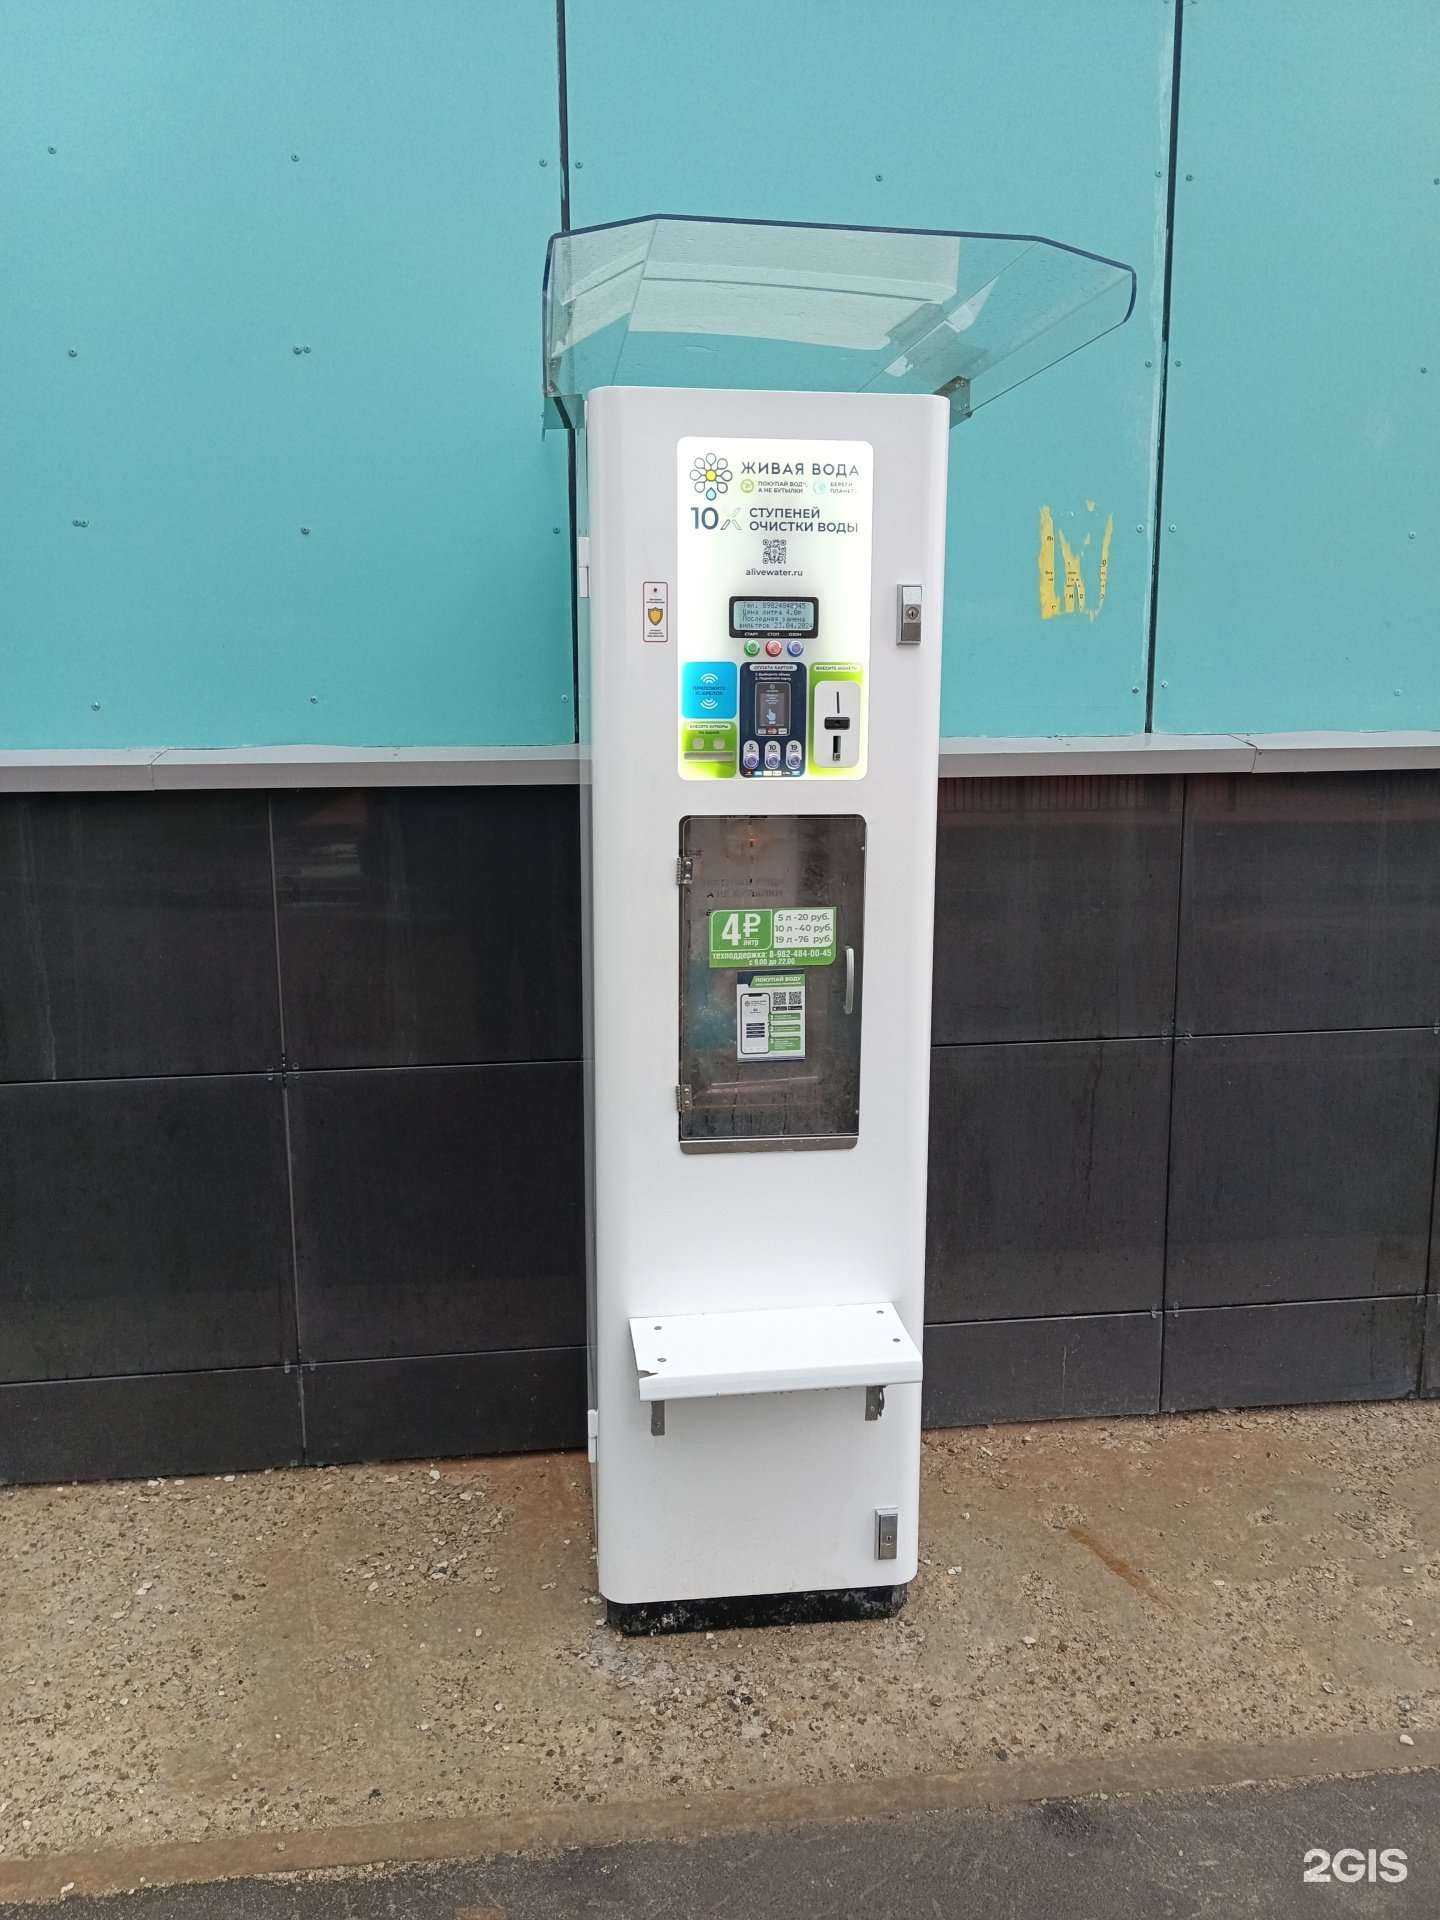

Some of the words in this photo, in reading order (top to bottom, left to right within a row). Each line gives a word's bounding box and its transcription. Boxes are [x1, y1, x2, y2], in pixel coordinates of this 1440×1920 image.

[741, 462, 805, 475] ЖИВАЯ
[811, 463, 860, 478] ВОДА
[749, 506, 821, 518] СТУПЕНЕЙ
[749, 521, 814, 532] ОЧИСТКИ
[818, 522, 859, 534] ВОДЫ
[745, 568, 803, 576] alivewater.ru
[777, 913, 784, 921] 5
[810, 912, 830, 922] руб.
[775, 924, 785, 932] 10
[813, 923, 833, 933] руб.
[775, 935, 785, 944] 19
[813, 934, 832, 944] руб.
